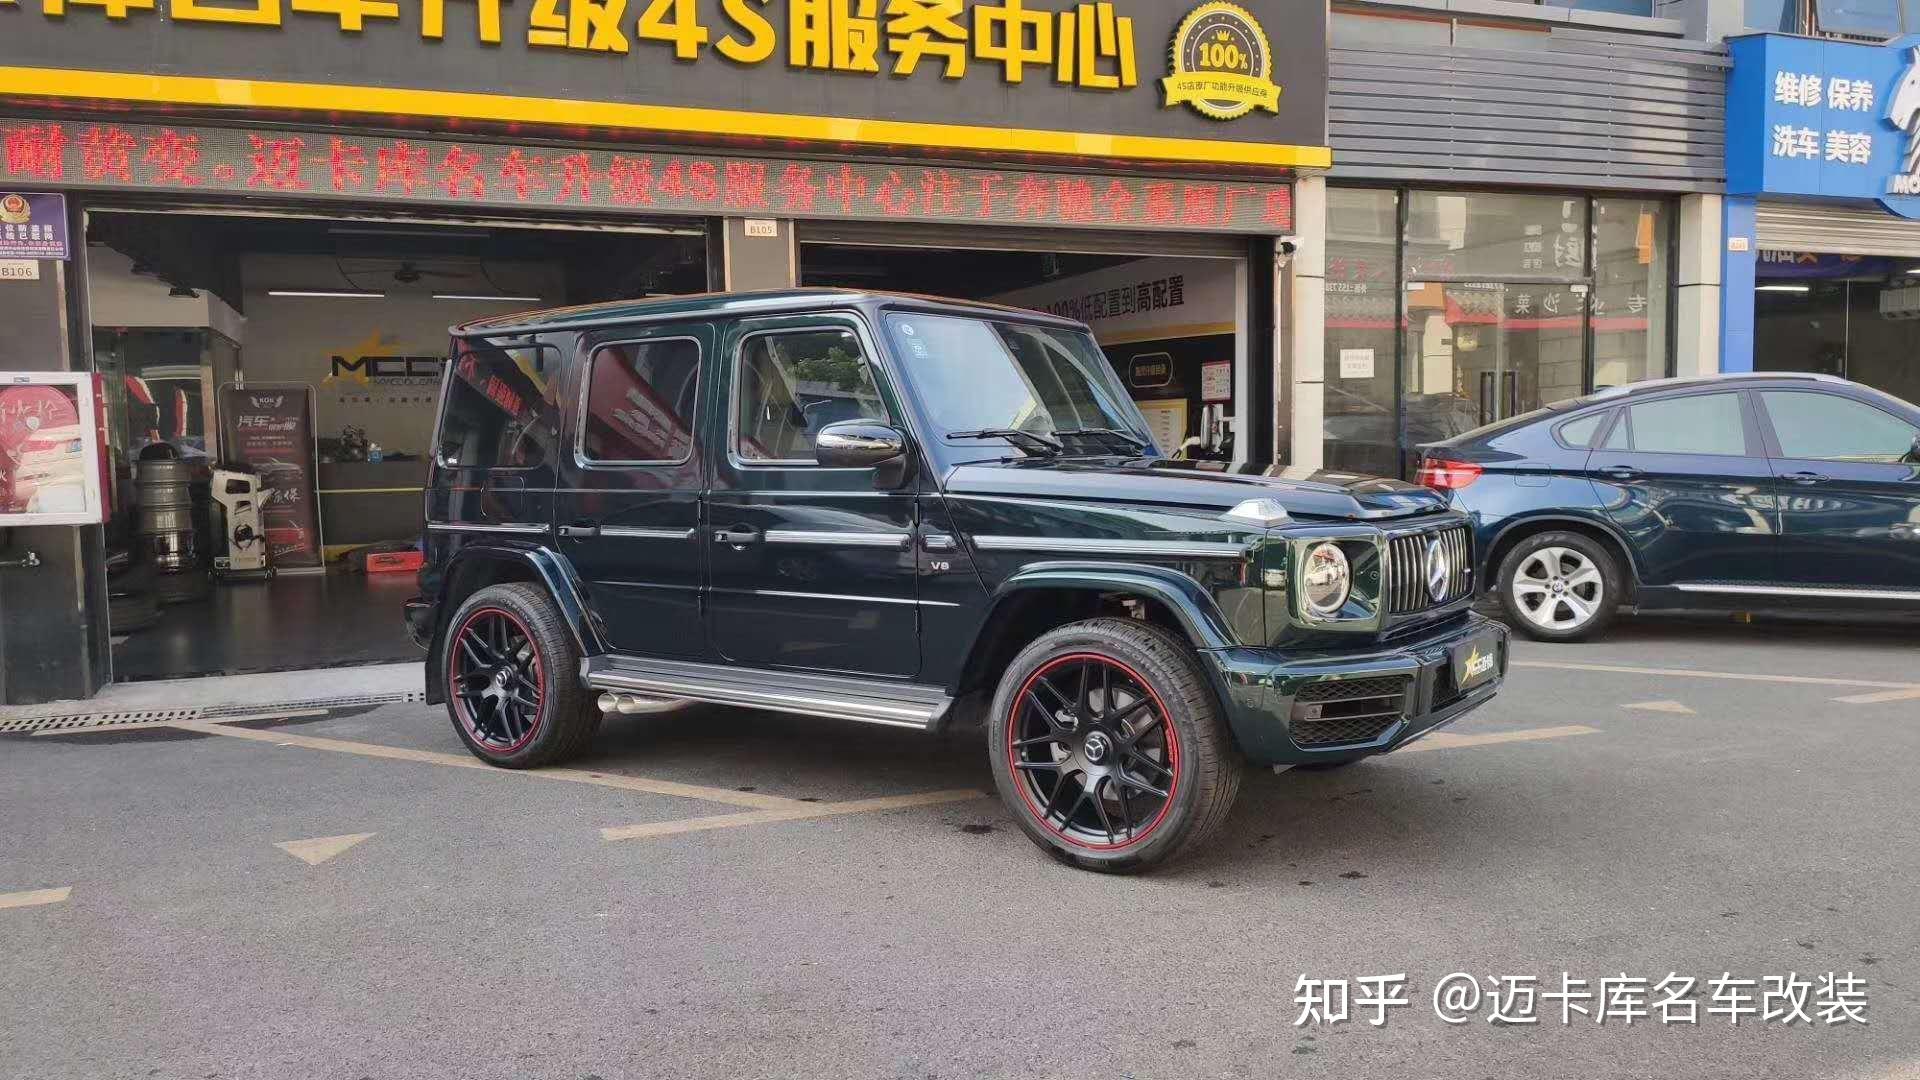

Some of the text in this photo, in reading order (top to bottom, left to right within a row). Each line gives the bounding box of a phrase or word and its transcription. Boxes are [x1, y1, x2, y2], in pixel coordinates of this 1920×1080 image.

[1199, 42, 1248, 69] 100%
[1774, 71, 1874, 112] 维修 保养
[1772, 125, 1872, 164] 洗车 美容
[750, 225, 773, 234] B105
[2, 267, 33, 277] B106
